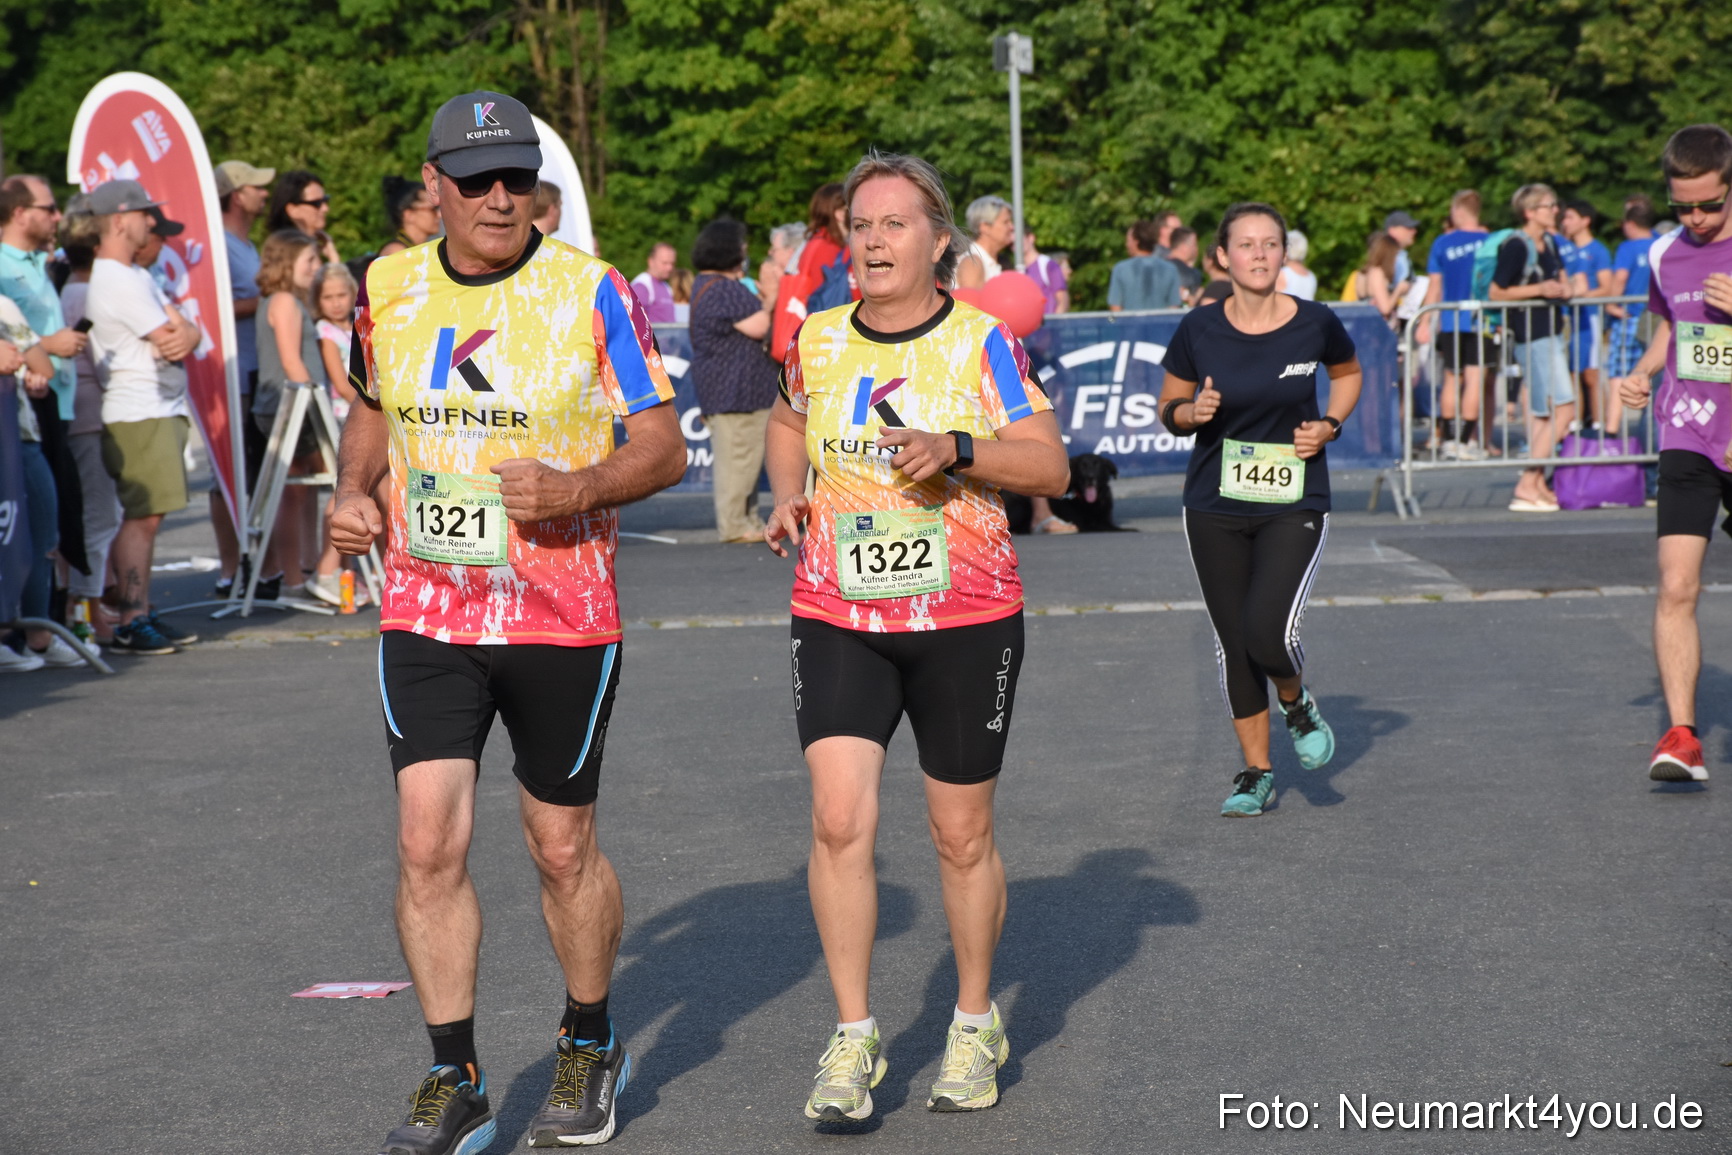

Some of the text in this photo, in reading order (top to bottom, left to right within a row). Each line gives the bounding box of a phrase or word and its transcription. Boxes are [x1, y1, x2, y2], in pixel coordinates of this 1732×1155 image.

[466, 129, 511, 140] KÜFNER
[1071, 384, 1158, 430] Fis
[397, 406, 529, 429] KÜFNER
[434, 429, 455, 438] UND
[458, 430, 497, 440] TIEFBAU
[500, 431, 530, 441] GMBH
[1093, 432, 1197, 456] AUTOM
[823, 438, 899, 456] KÜFN
[1232, 463, 1292, 487] 1449
[477, 499, 500, 507] 2019
[416, 501, 486, 539] 1321
[423, 536, 476, 548] Küfner Reiner
[917, 528, 938, 538] 2019
[849, 538, 933, 574] 1322
[861, 572, 923, 584] Küfner Sandra
[897, 580, 920, 588] Tiefbau
[920, 578, 939, 586] GmbH
[996, 647, 1012, 711] odlo
